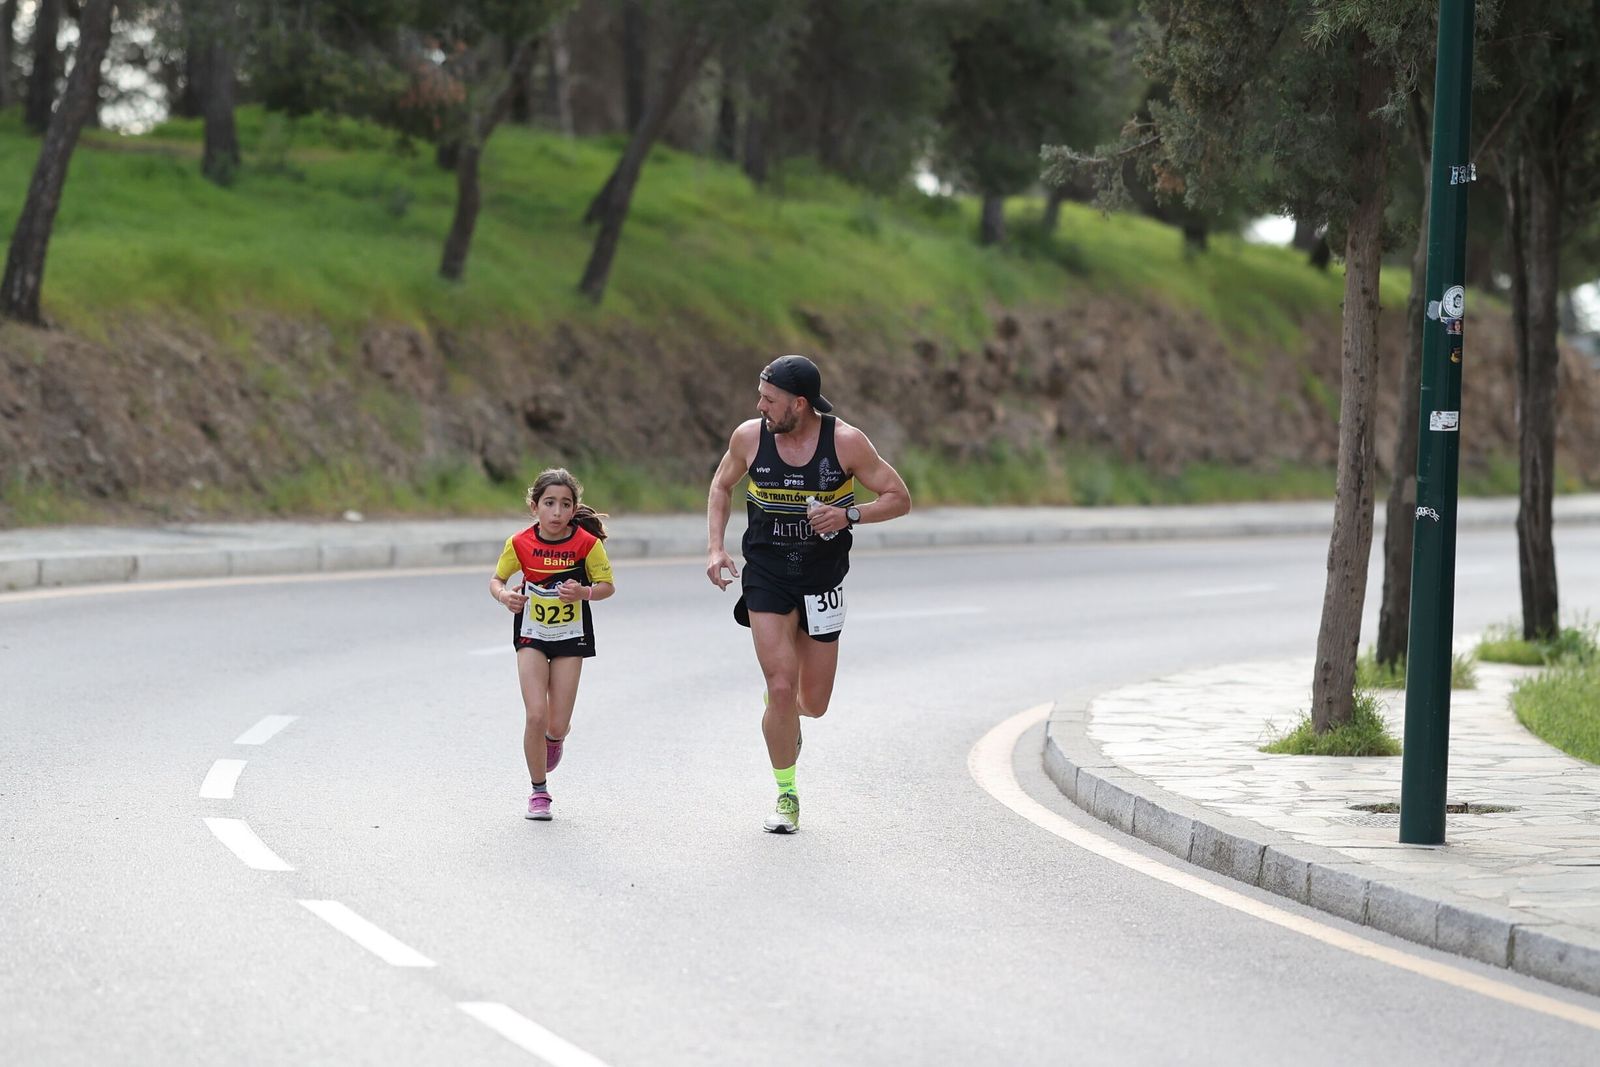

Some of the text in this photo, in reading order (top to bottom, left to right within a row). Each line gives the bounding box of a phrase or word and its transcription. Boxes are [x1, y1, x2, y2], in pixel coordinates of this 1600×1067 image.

[783, 478, 805, 487] gross
[769, 492, 807, 503] TRIATLÓN
[807, 492, 836, 503] ÁLAGA
[532, 548, 576, 560] Málaga
[543, 557, 575, 567] Bahía
[816, 587, 843, 612] 307
[534, 603, 575, 625] 923
